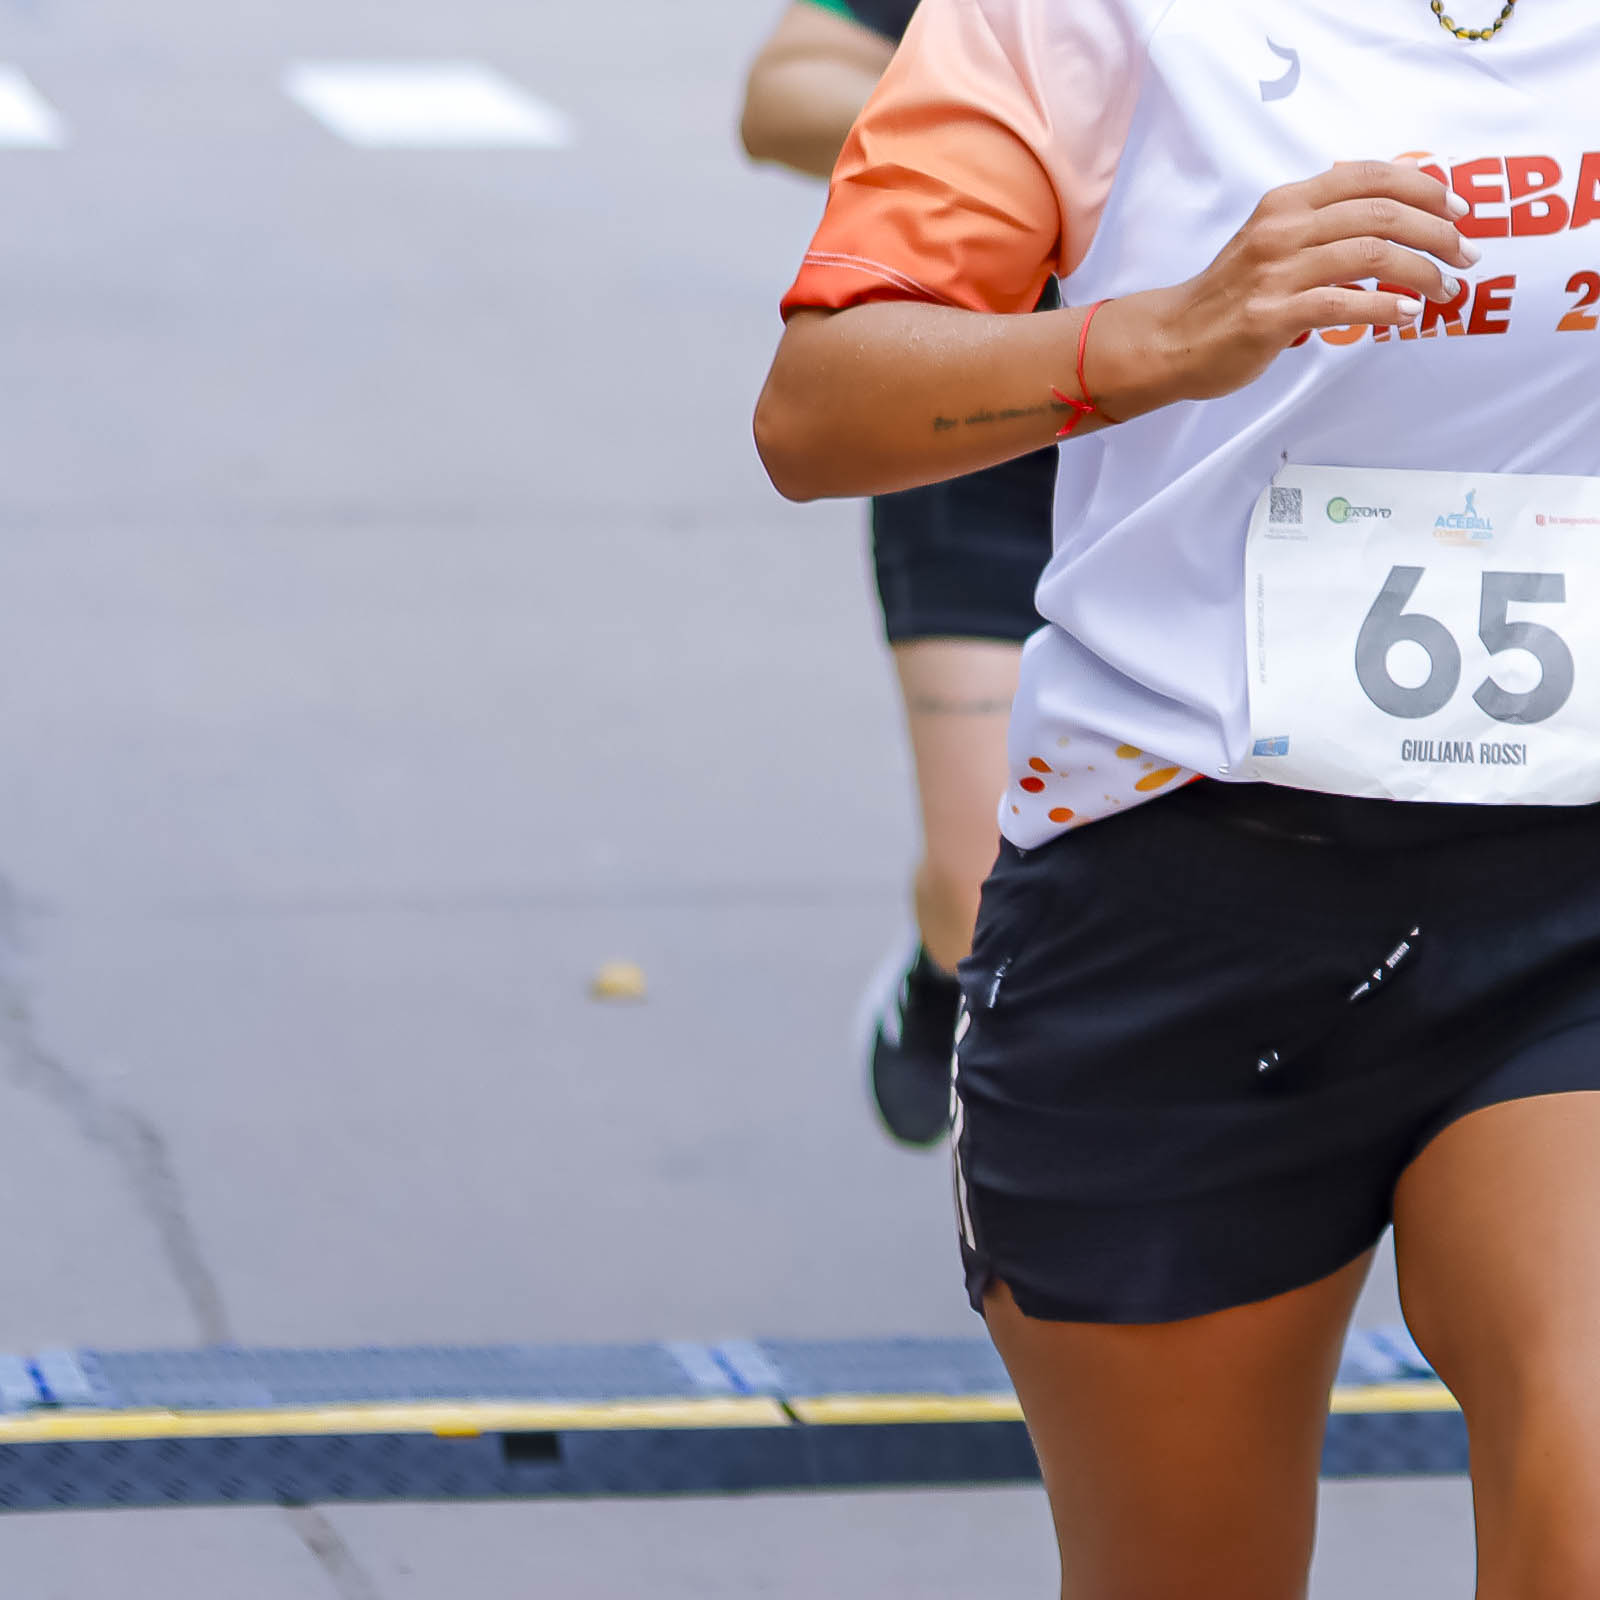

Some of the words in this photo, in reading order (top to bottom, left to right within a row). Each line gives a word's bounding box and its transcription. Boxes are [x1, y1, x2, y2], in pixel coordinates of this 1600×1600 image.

[1355, 565, 1575, 725] 65
[1401, 739, 1475, 764] GIULIANA
[1479, 742, 1527, 766] ROSSI
